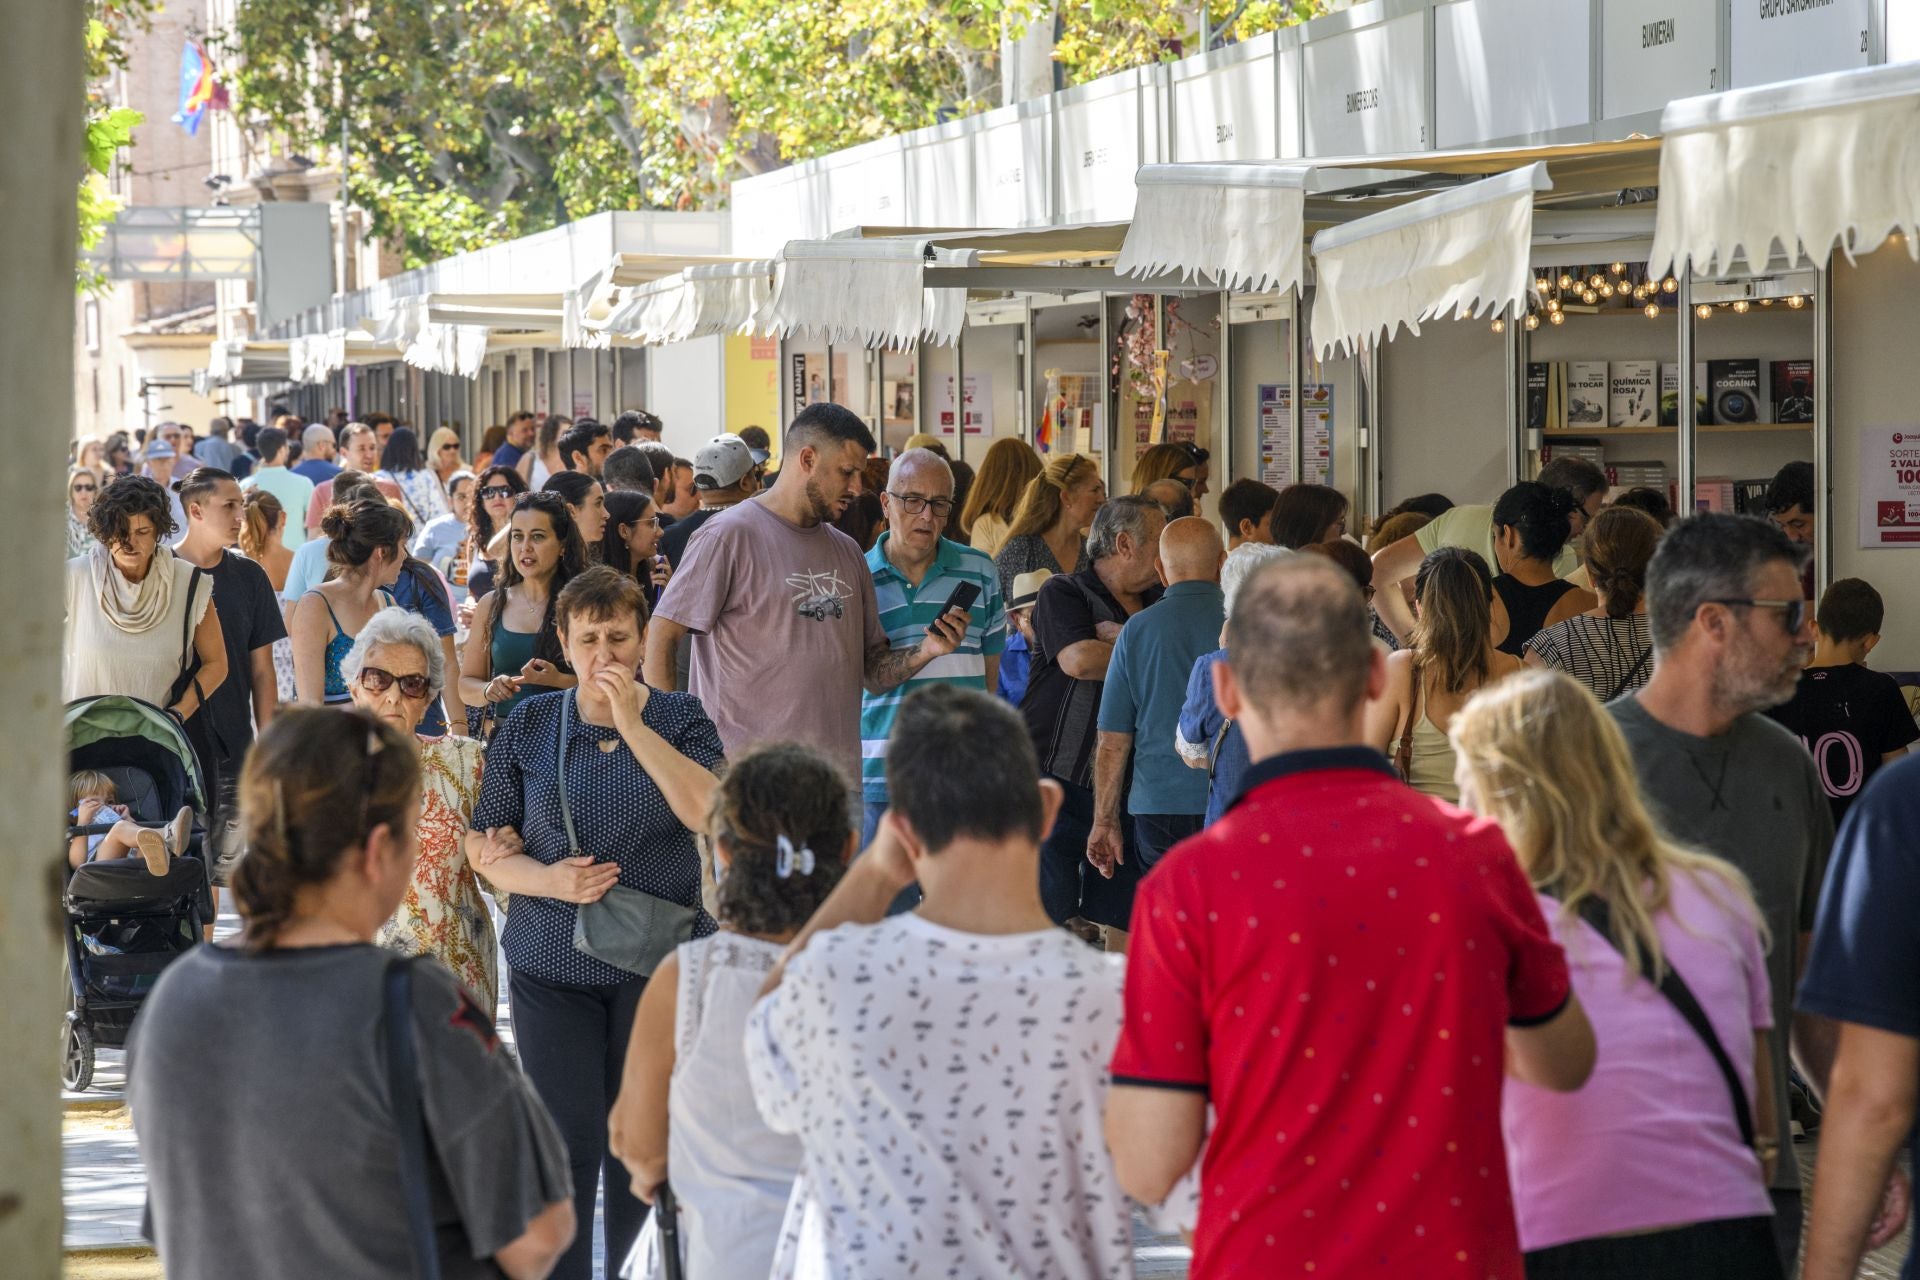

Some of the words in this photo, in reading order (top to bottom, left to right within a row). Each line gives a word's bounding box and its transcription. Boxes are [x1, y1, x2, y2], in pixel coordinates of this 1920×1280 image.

[1860, 30, 1868, 53] 28
[1710, 68, 1717, 89] 27
[1613, 377, 1651, 387] QUÍMICA
[1716, 379, 1757, 388] COCAÍNA
[1613, 387, 1637, 395] ROSA
[1890, 460, 1897, 468] 2
[1793, 730, 1864, 798] 0
